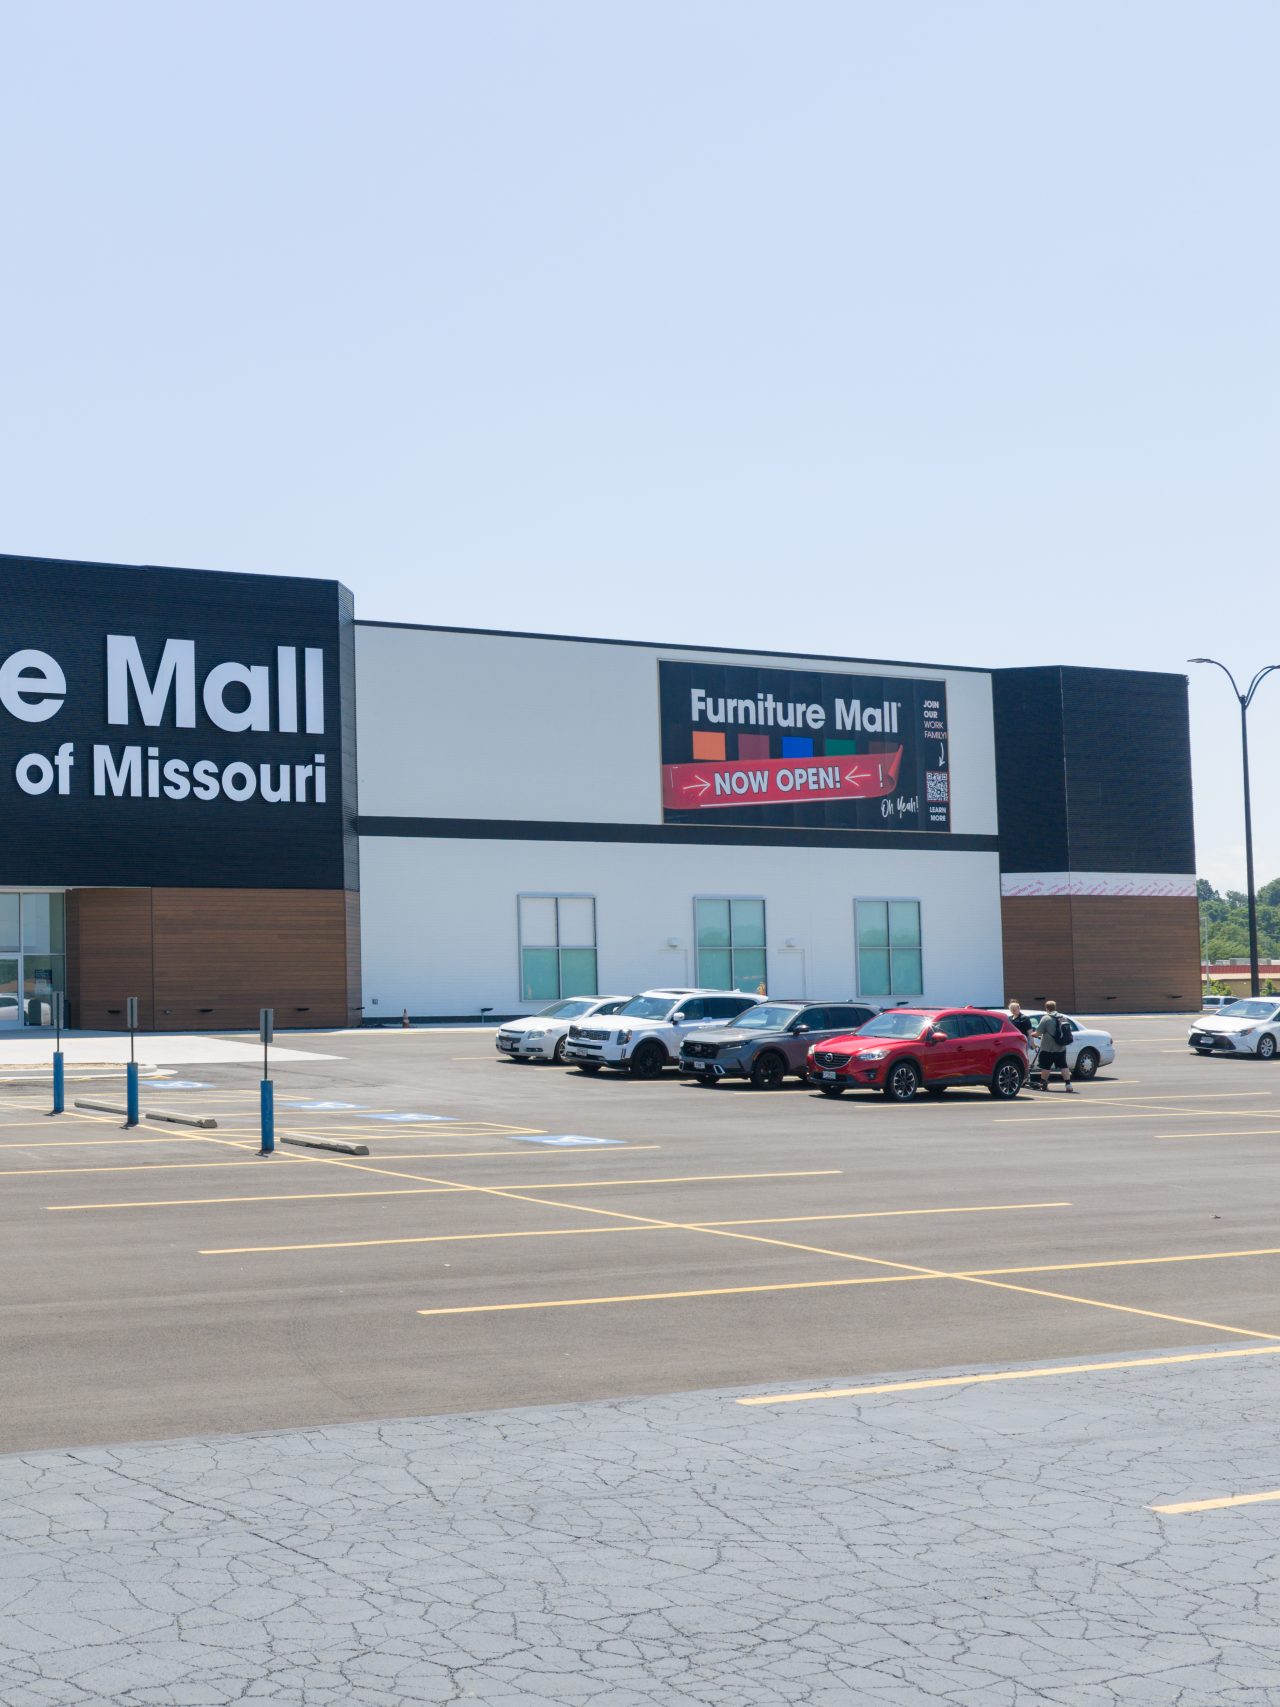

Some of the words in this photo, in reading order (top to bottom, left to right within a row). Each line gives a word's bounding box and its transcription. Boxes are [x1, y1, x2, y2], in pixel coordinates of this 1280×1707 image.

[106, 634, 325, 735] Mall
[690, 688, 826, 730] Furniture
[835, 698, 898, 733] Mall
[923, 700, 940, 709] JOIN
[923, 710, 938, 719] OUR
[923, 720, 944, 730] WORK
[15, 742, 75, 796] of
[92, 745, 327, 804] Missouri
[714, 770, 769, 796] NOW
[776, 766, 841, 792] OPEN!
[881, 798, 894, 818] Oh
[897, 795, 920, 819] Yeah!
[929, 806, 947, 814] LEARN
[930, 814, 947, 822] MORE
